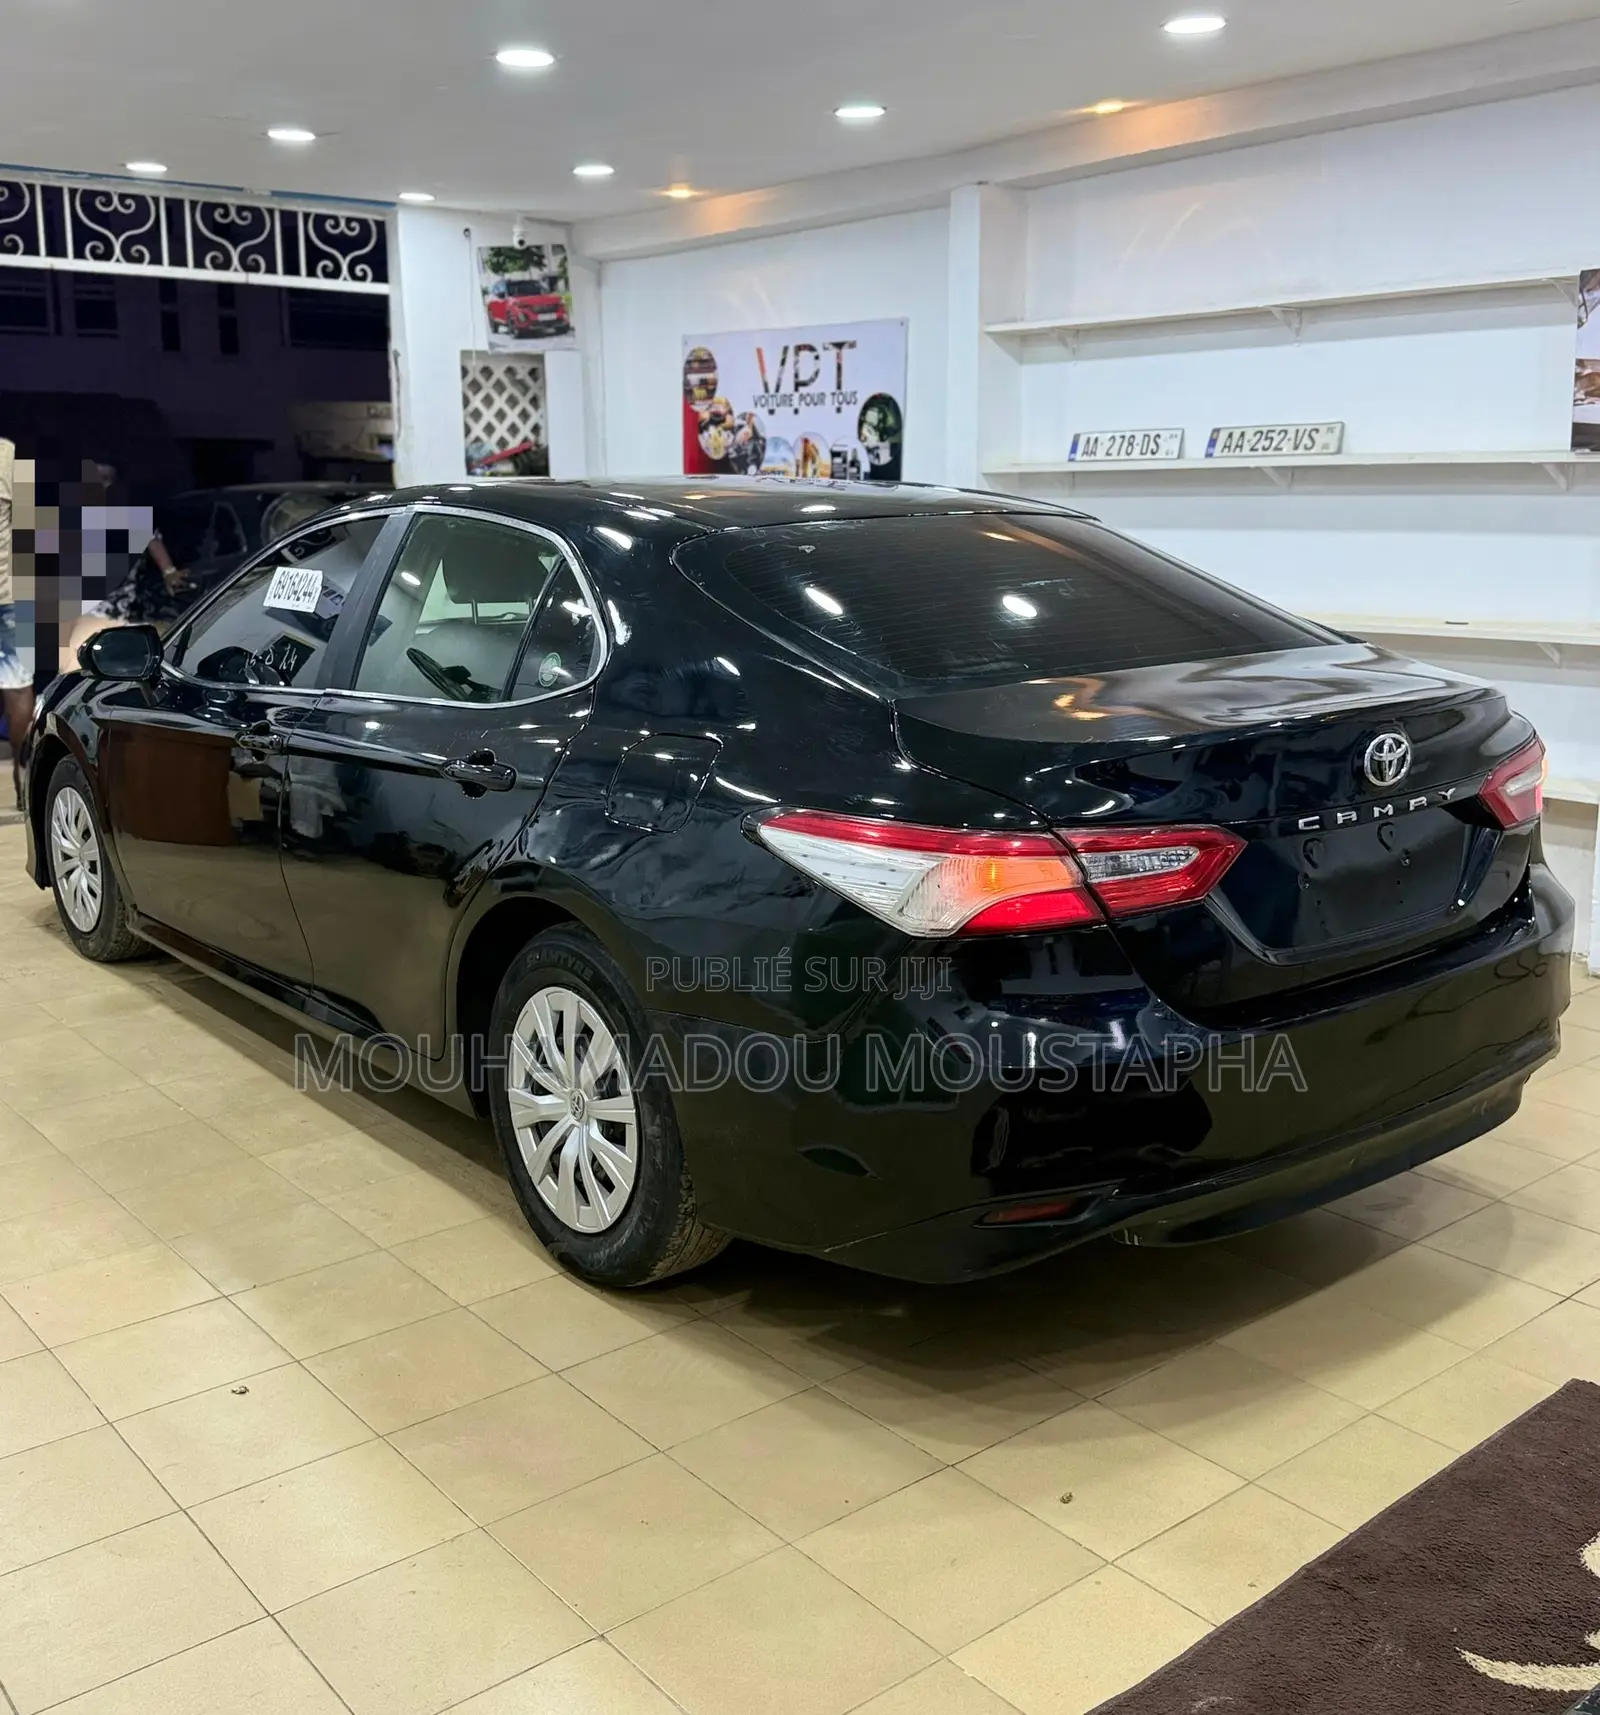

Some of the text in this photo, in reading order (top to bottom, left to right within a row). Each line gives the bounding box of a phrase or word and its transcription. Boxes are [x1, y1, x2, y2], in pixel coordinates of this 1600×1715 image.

[753, 390, 858, 409] VOITURE POUR TOUS
[273, 570, 319, 603] 69164244
[1298, 787, 1456, 831] CAMRY
